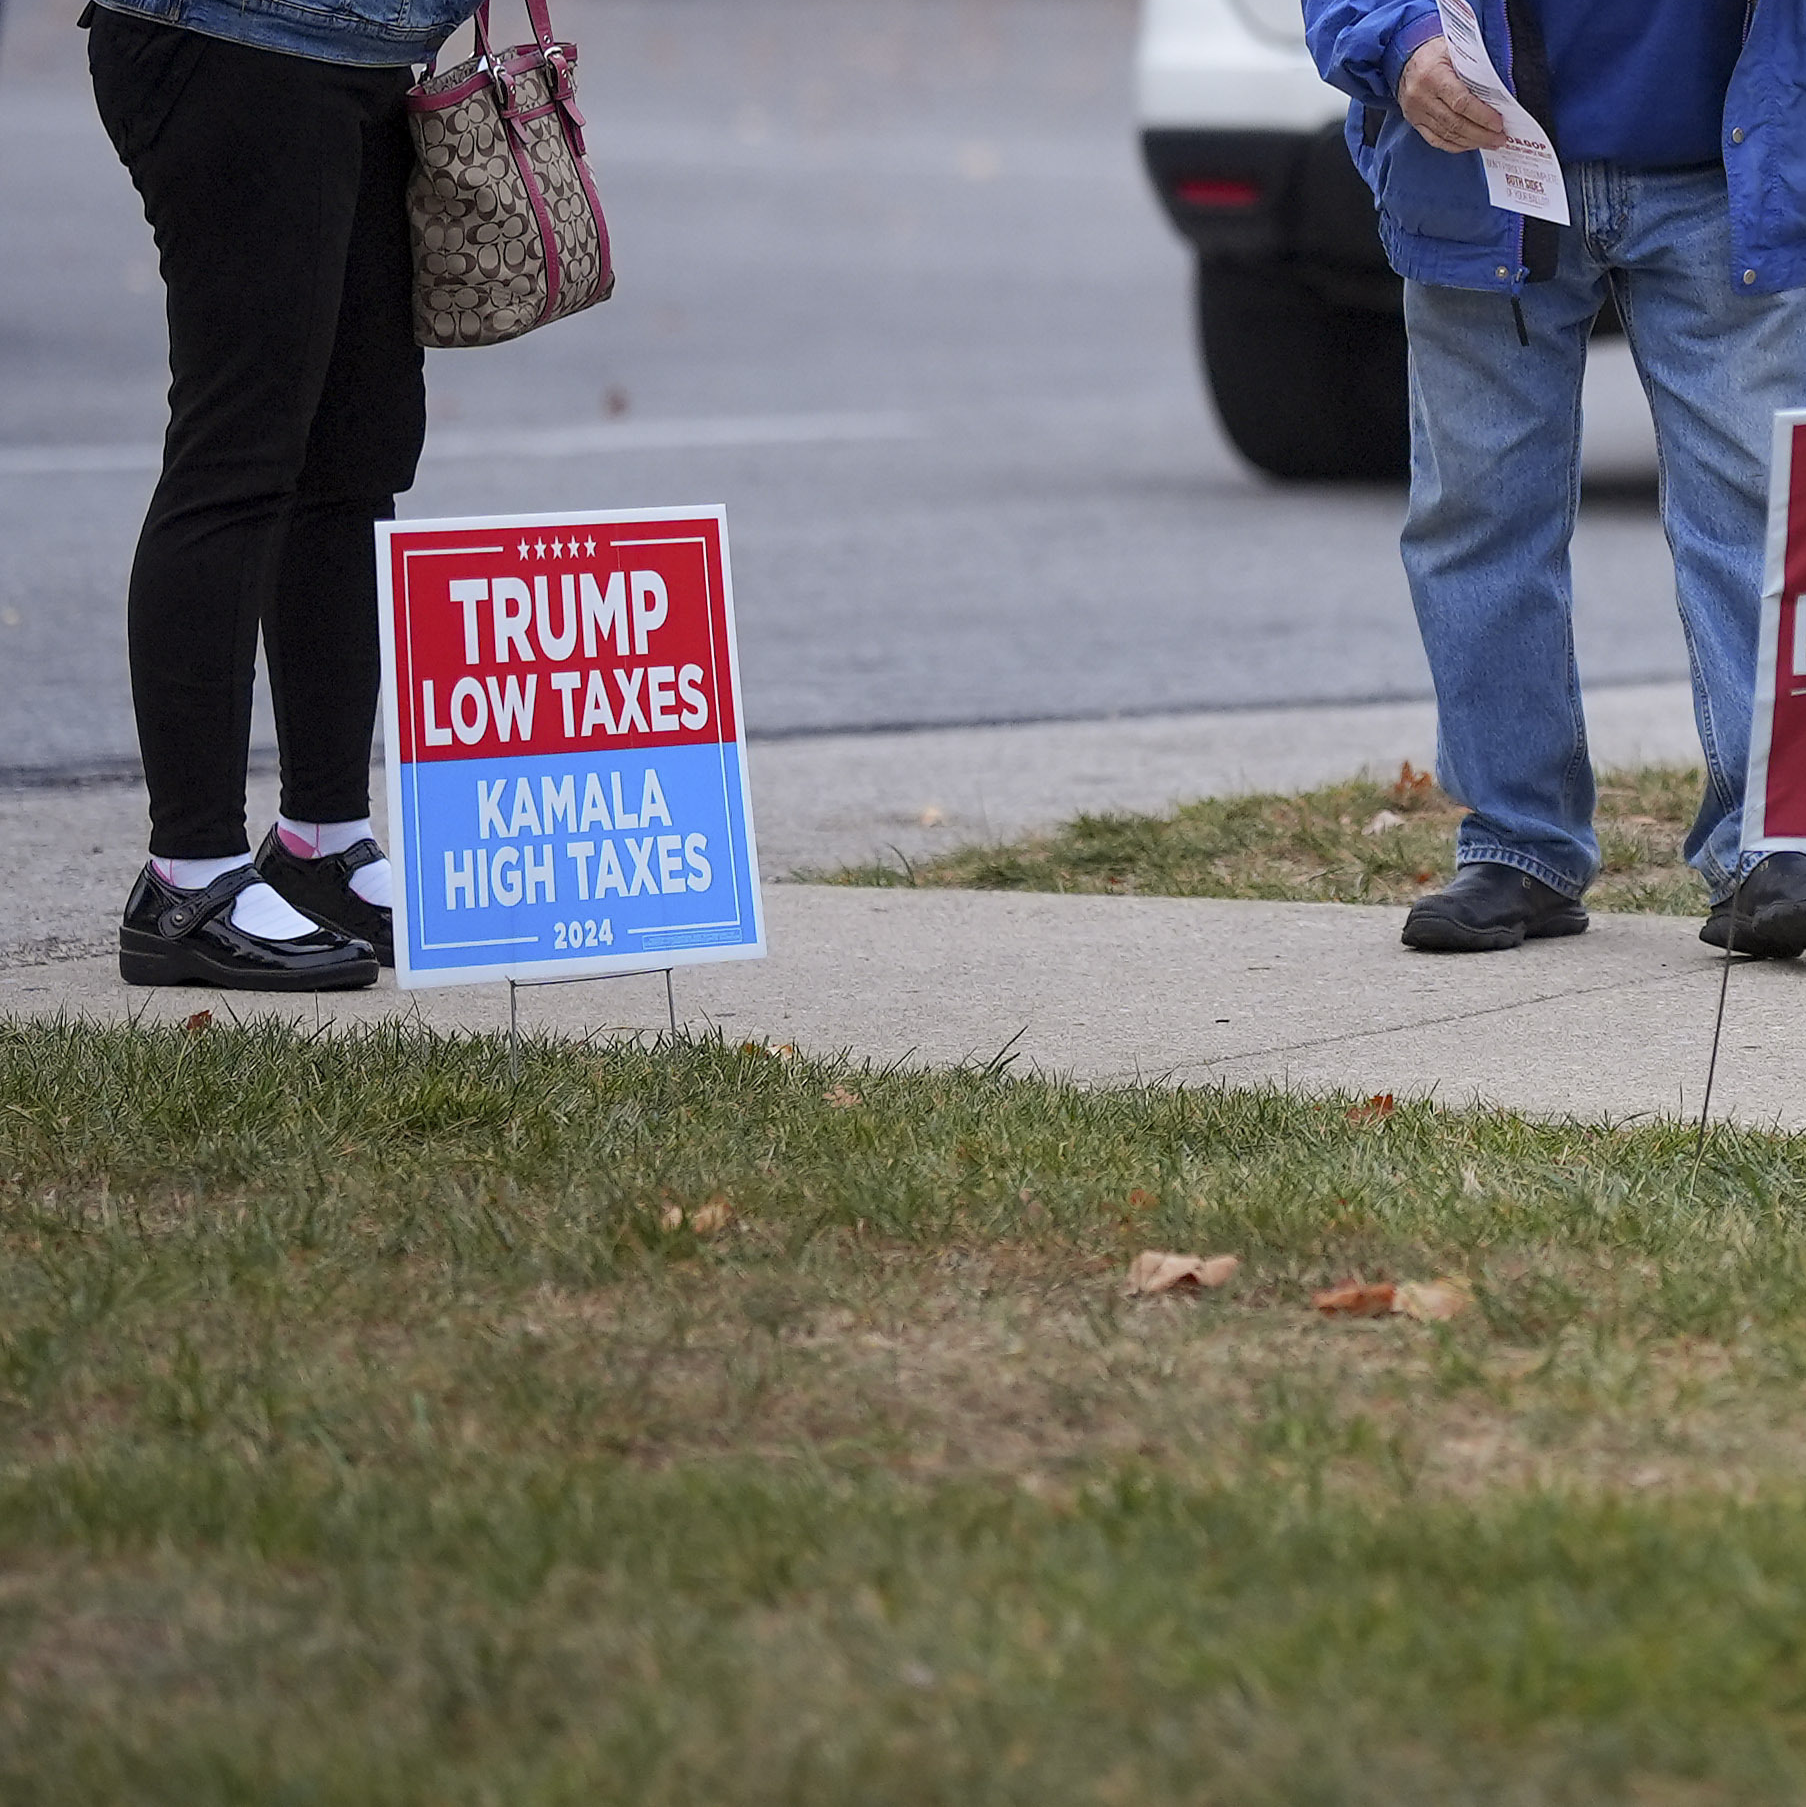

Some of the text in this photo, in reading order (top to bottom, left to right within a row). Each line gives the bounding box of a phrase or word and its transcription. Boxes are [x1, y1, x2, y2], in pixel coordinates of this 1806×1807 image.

[449, 569, 669, 665] TRUMP
[422, 663, 709, 747] LOW TAXES
[476, 768, 673, 839] KAMALA
[444, 833, 713, 911] HIGH TAXES
[553, 917, 614, 950] 2024
